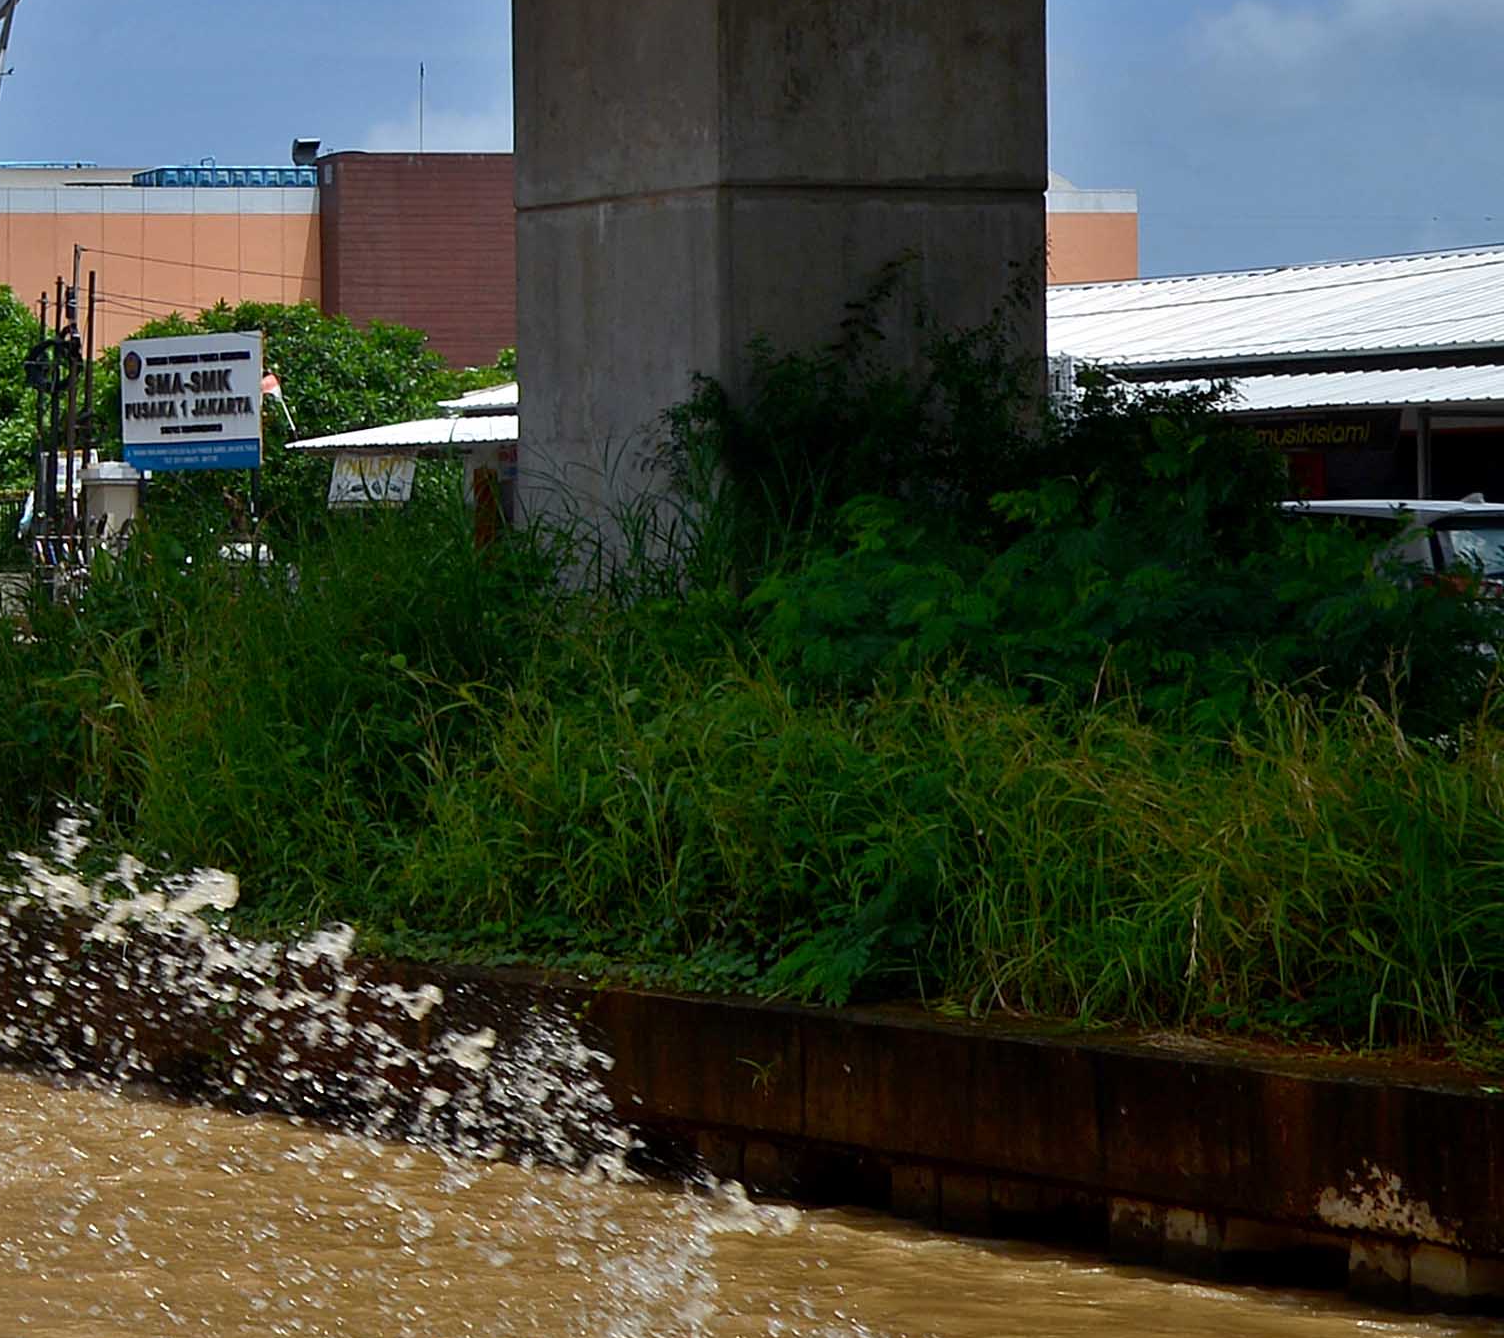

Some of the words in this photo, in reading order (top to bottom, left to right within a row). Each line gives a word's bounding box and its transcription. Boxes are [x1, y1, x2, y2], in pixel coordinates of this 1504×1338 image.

[144, 368, 233, 396] SMA-SMK
[125, 400, 178, 421] PUSAKA
[180, 399, 188, 418] 1
[191, 396, 255, 417] JAKARTA
